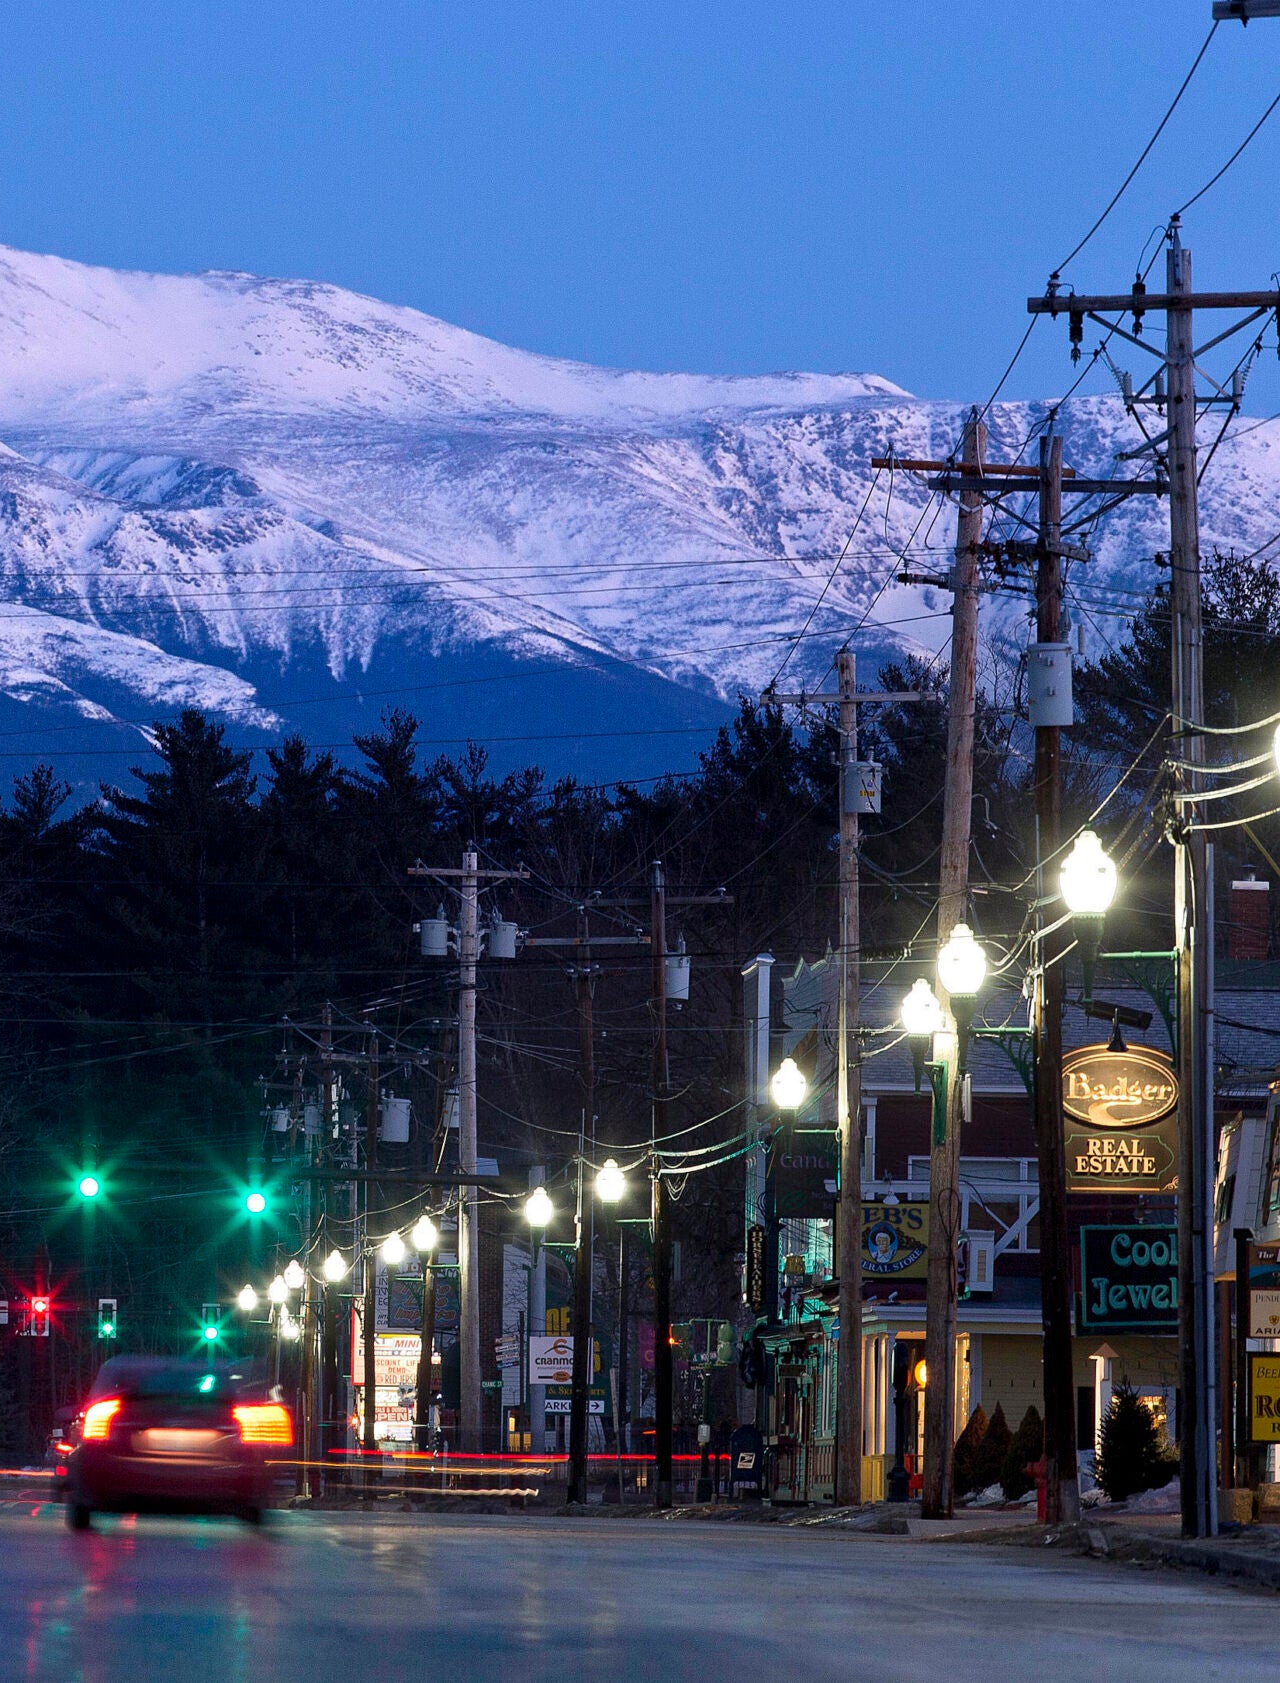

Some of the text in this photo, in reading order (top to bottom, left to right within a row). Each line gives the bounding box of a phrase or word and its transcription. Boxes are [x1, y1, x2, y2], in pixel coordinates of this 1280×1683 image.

[1066, 1072, 1172, 1101] Badger
[1086, 1138, 1145, 1156] REAL
[780, 1152, 832, 1169] Cand
[1075, 1156, 1156, 1174] ESTATE
[861, 1207, 923, 1230] EB'S
[1111, 1233, 1178, 1266] Cool
[1258, 1250, 1274, 1259] The
[862, 1248, 923, 1273] ERAL STORE
[1091, 1277, 1178, 1315] Jewel
[376, 1359, 401, 1367] SCOUNT
[374, 1413, 408, 1421] PEN
